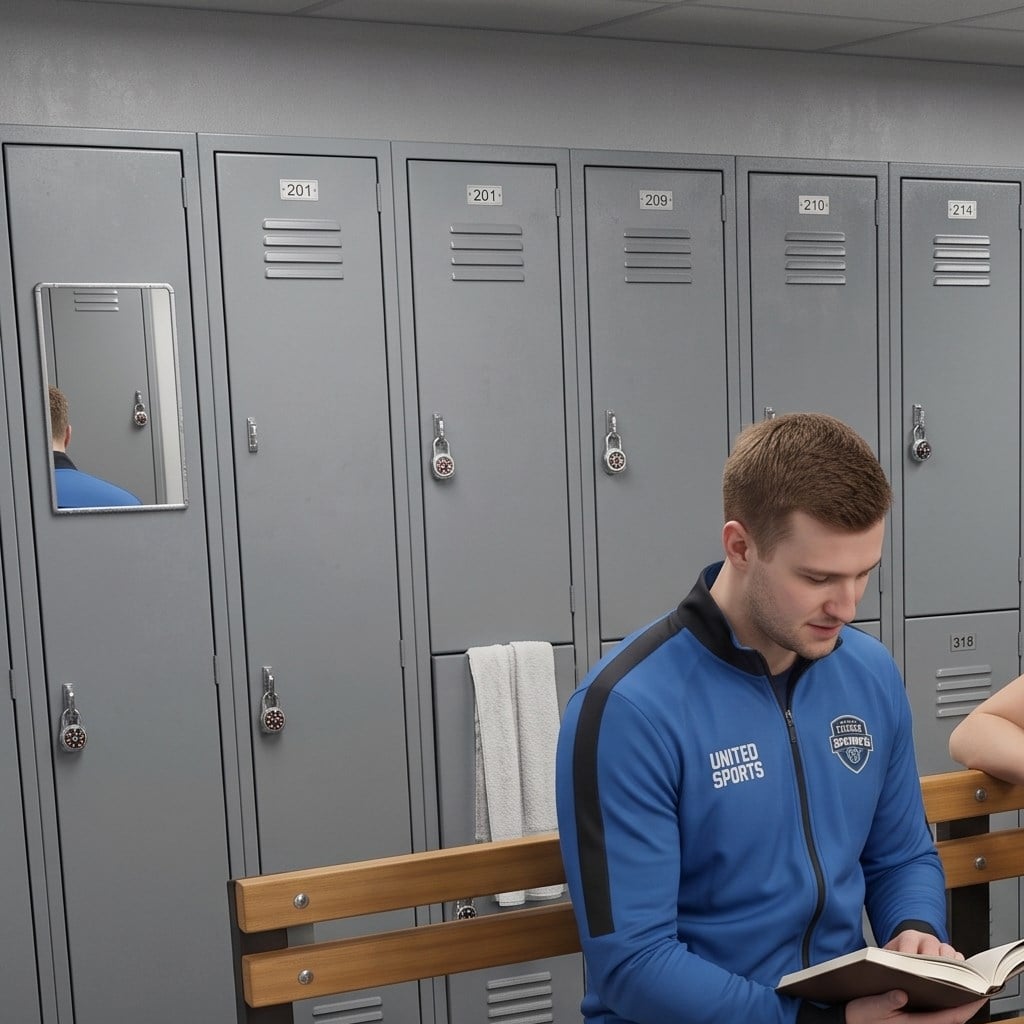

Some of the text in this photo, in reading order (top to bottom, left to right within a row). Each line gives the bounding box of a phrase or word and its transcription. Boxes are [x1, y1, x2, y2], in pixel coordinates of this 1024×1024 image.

[287, 184, 312, 197] 201
[474, 190, 497, 202] 201
[645, 195, 668, 206] 209
[804, 200, 825, 211] 210
[953, 205, 973, 215] 214
[954, 636, 974, 648] 318
[709, 743, 759, 770] UNITED
[712, 761, 765, 789] SPORTS
